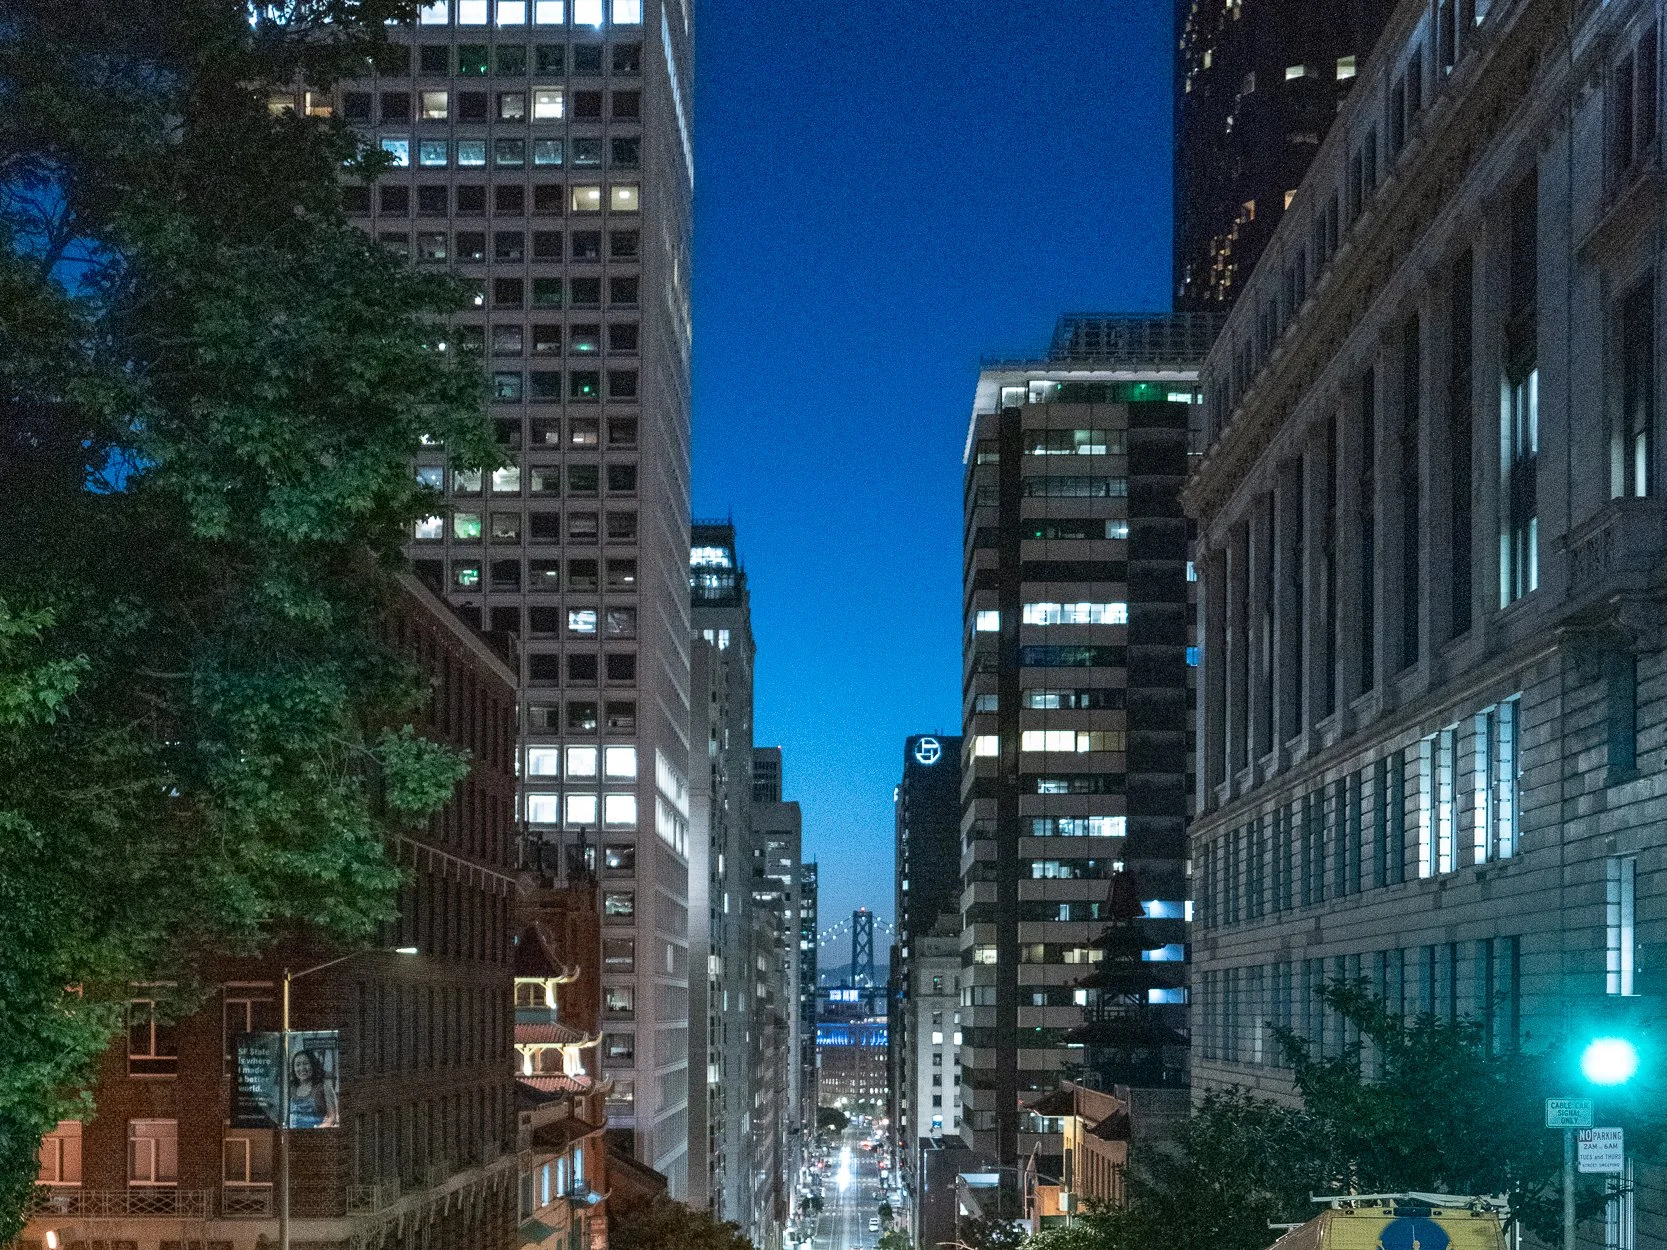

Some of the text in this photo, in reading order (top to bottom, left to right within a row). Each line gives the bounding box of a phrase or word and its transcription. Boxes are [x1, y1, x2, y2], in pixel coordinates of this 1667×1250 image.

[250, 1048, 270, 1056] State
[247, 1057, 271, 1065] where
[243, 1066, 264, 1074] made
[244, 1075, 269, 1083] better
[1557, 1109, 1581, 1117] SIGNAL
[1579, 1129, 1622, 1141] NO PARKING
